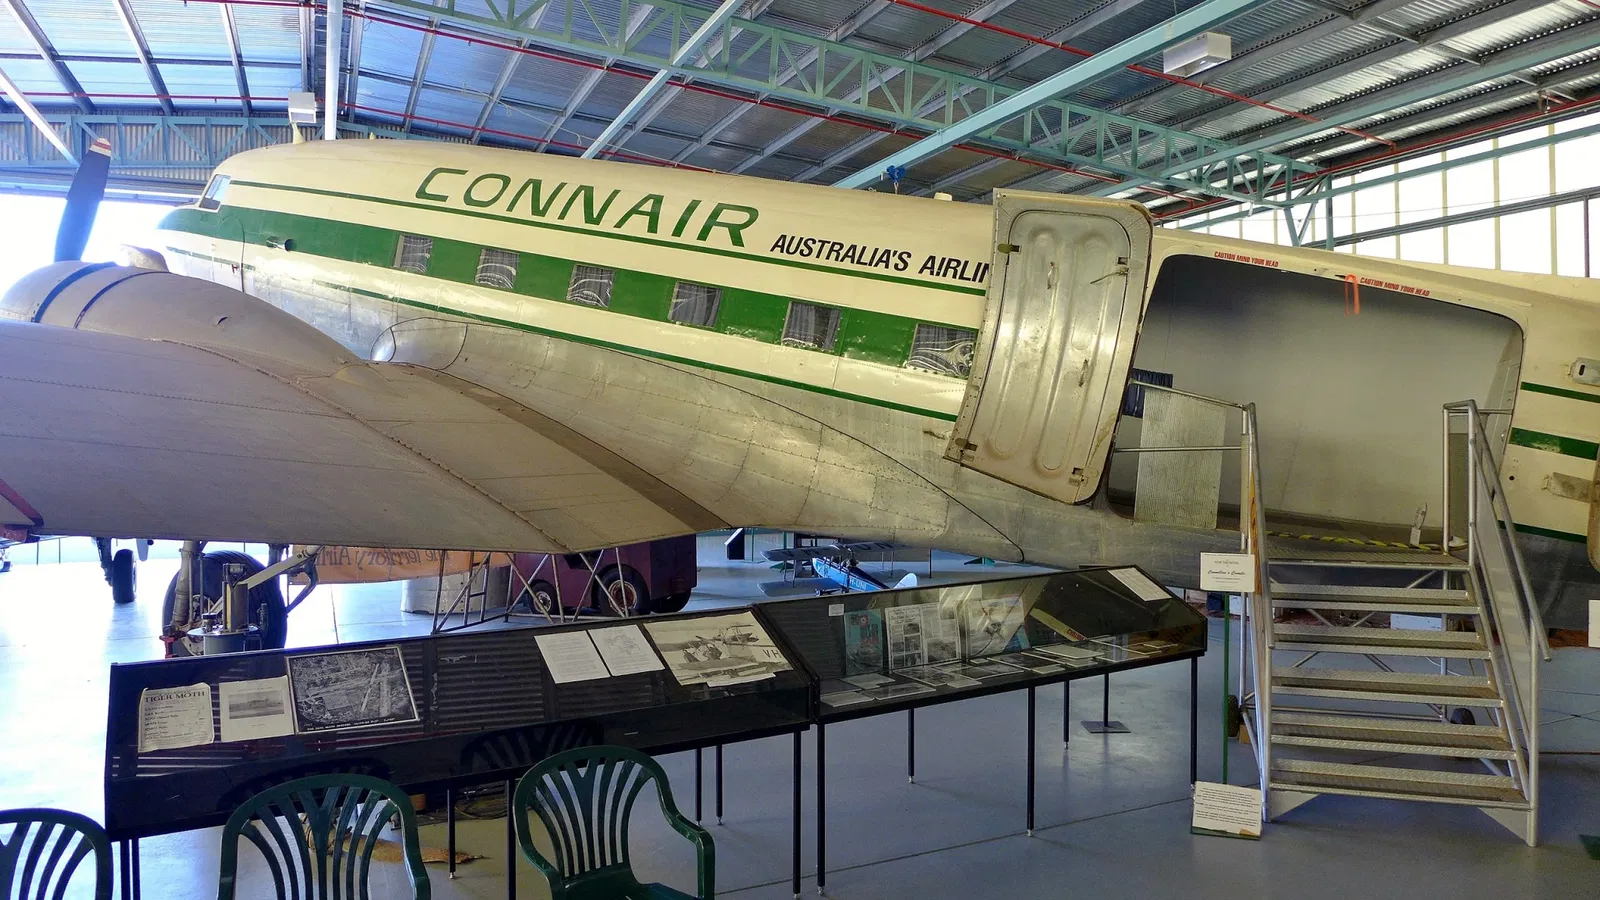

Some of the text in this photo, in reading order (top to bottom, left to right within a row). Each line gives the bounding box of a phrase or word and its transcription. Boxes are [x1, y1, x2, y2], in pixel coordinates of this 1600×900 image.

[415, 167, 759, 248] CONNAIR
[770, 234, 912, 271] AUSTRALIA'S
[1214, 251, 1279, 268] CAUTION MIND YOUR HEAD
[1360, 277, 1430, 297] CAUTION MIND YOUR HEAD
[762, 649, 782, 659] VH
[145, 691, 205, 703] TIGER MOTH
